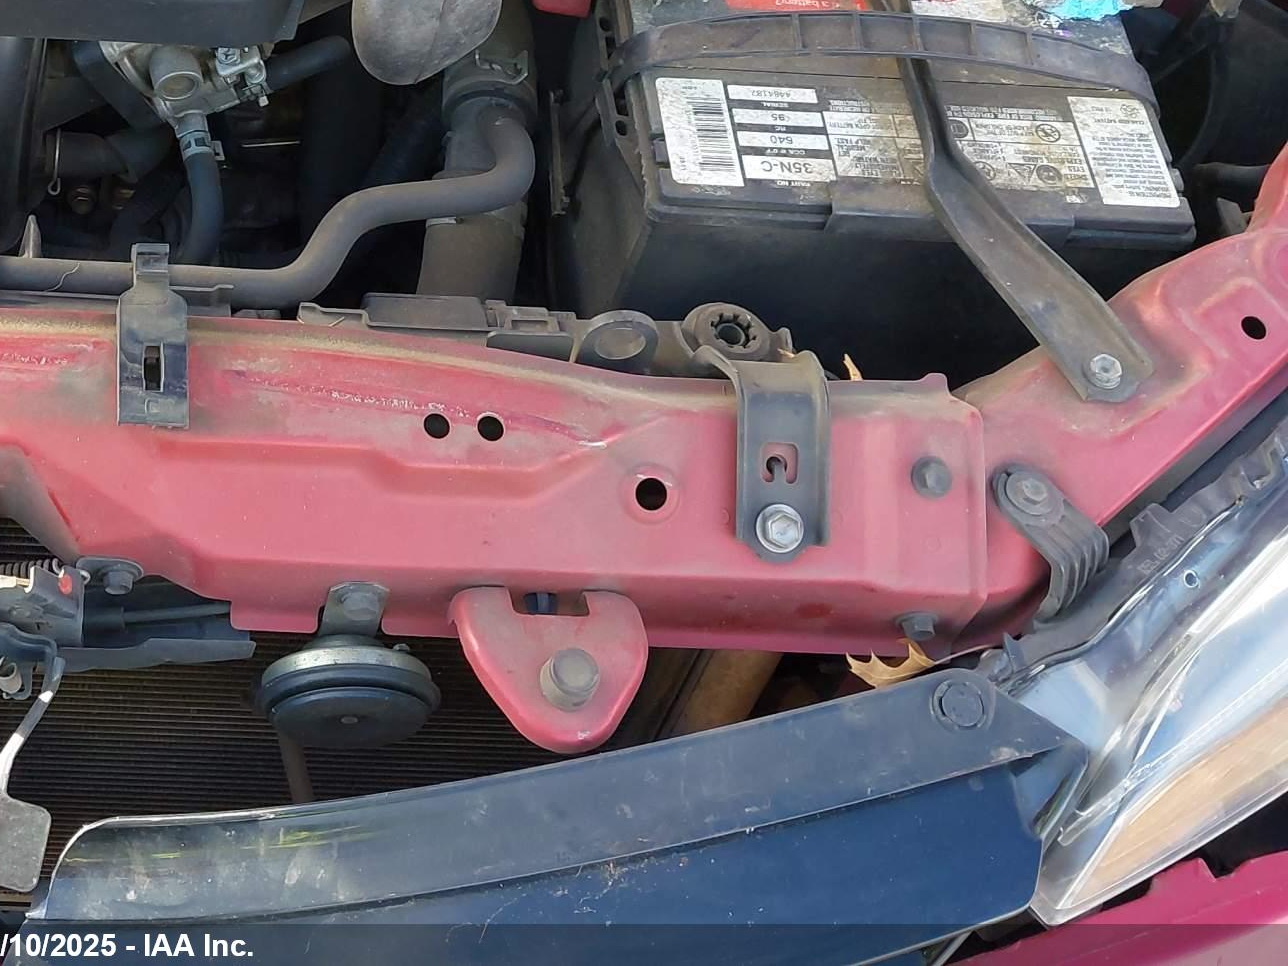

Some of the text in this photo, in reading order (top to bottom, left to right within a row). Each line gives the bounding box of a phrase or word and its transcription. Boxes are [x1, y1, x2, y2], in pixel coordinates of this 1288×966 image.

[770, 113, 786, 122] 95
[769, 135, 793, 145] 640
[760, 160, 814, 175] 35N-C
[790, 179, 812, 187] PART
